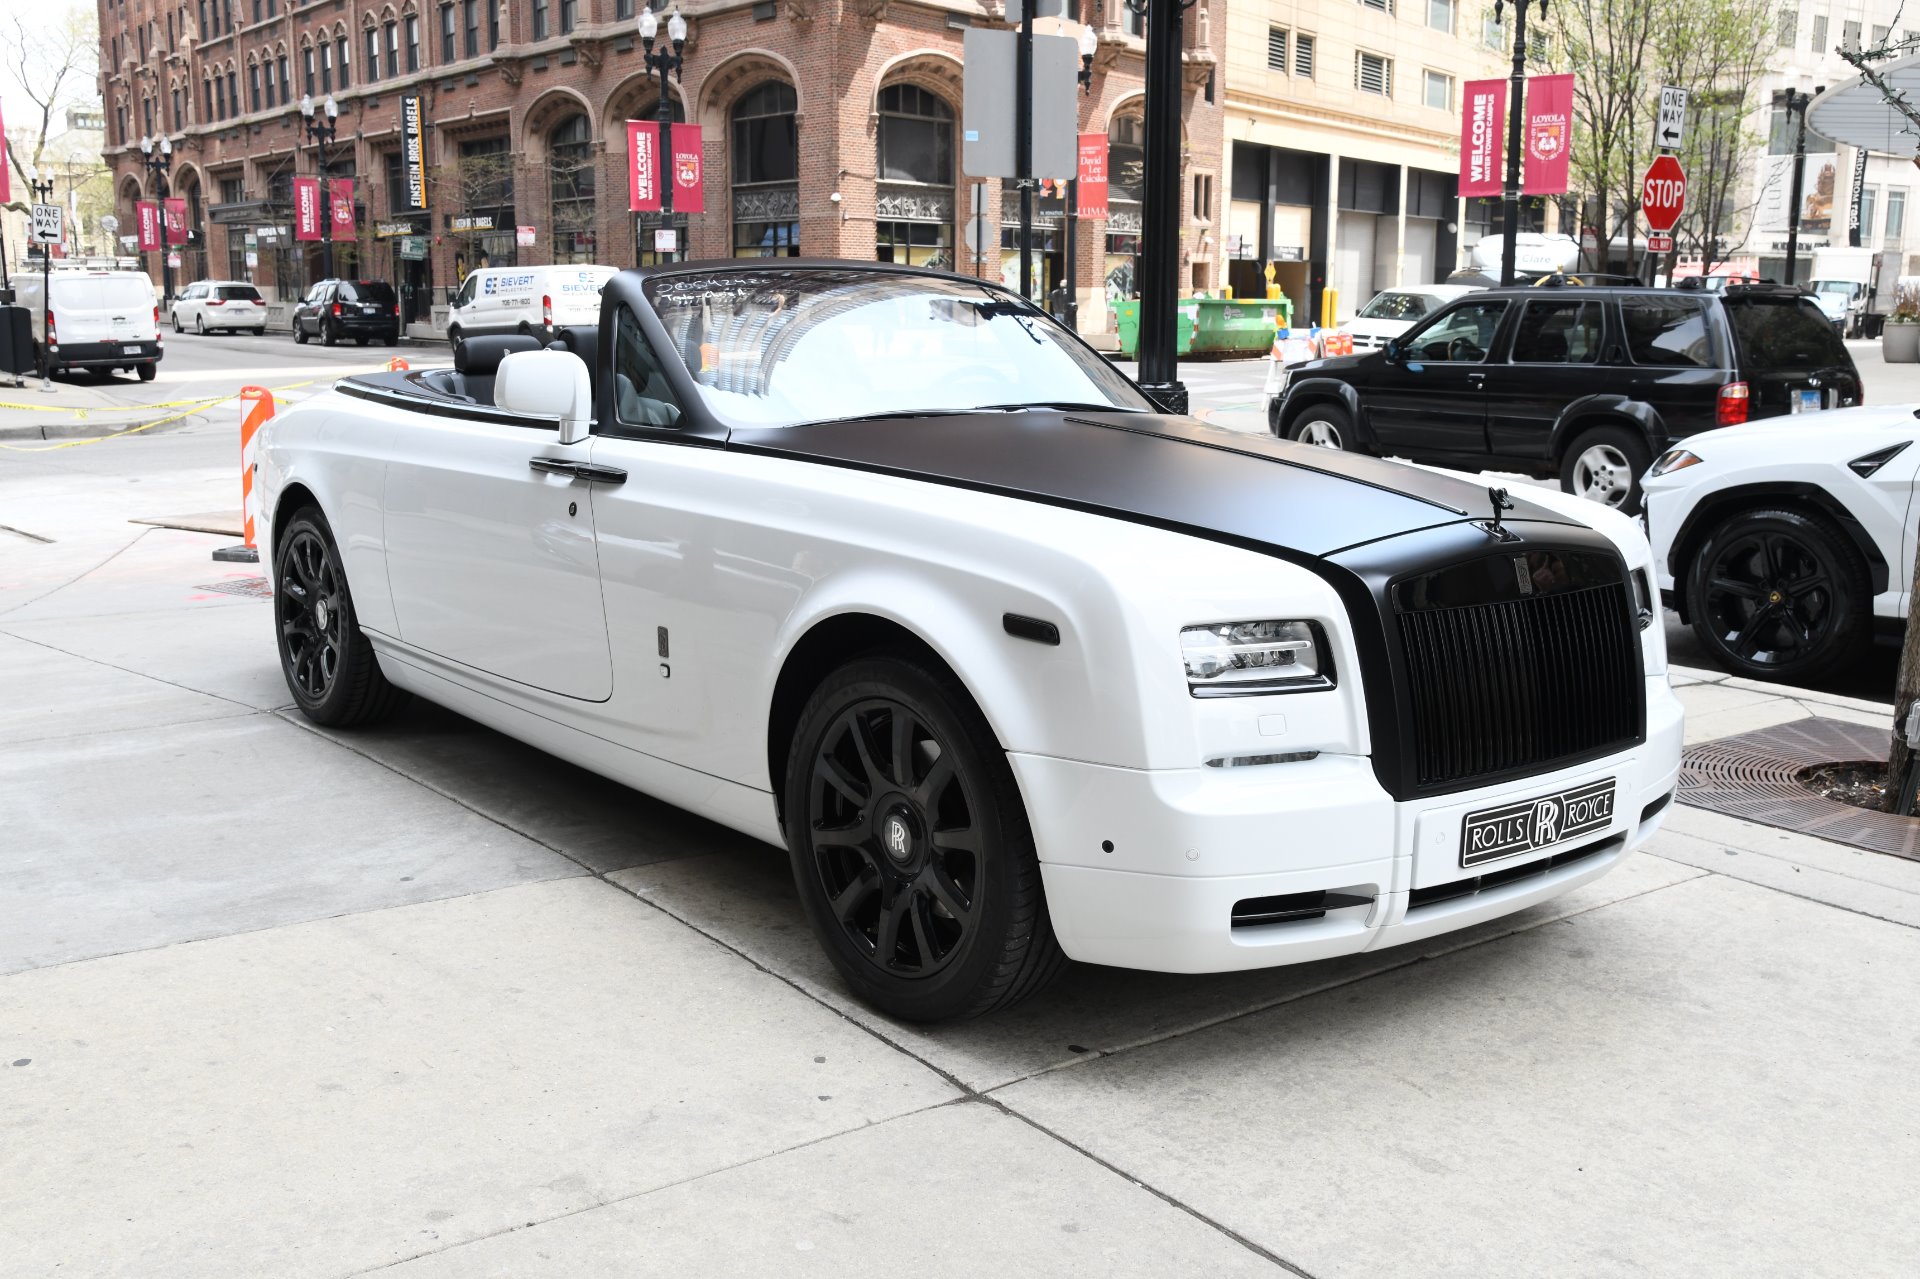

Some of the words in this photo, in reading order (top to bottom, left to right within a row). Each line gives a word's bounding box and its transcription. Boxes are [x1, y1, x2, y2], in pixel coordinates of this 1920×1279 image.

[1664, 90, 1684, 108] ONE
[406, 98, 418, 134] BAGELS
[1532, 114, 1566, 123] LOYOLA
[1662, 108, 1683, 124] WAY
[1470, 93, 1487, 183] WELCOME
[637, 132, 647, 199] WELCOME
[1081, 156, 1101, 165] David
[1089, 165, 1101, 173] Lee
[410, 164, 421, 206] EINSTEIN
[1852, 150, 1866, 201] ORDSTROM
[1645, 178, 1684, 208] STOP
[36, 207, 59, 218] ONE
[301, 186, 310, 232] WELCOME
[1077, 207, 1107, 217] LUMA
[1849, 204, 1860, 230] rack
[35, 218, 59, 229] WAY
[142, 208, 150, 244] WELCOME
[1650, 240, 1659, 249] ALL
[1660, 240, 1671, 250] WAY
[500, 275, 535, 287] SIEVERT
[1471, 818, 1524, 851] ROLLS
[1534, 800, 1559, 845] RR
[1567, 793, 1611, 826] ROYCE
[891, 820, 906, 854] RR
